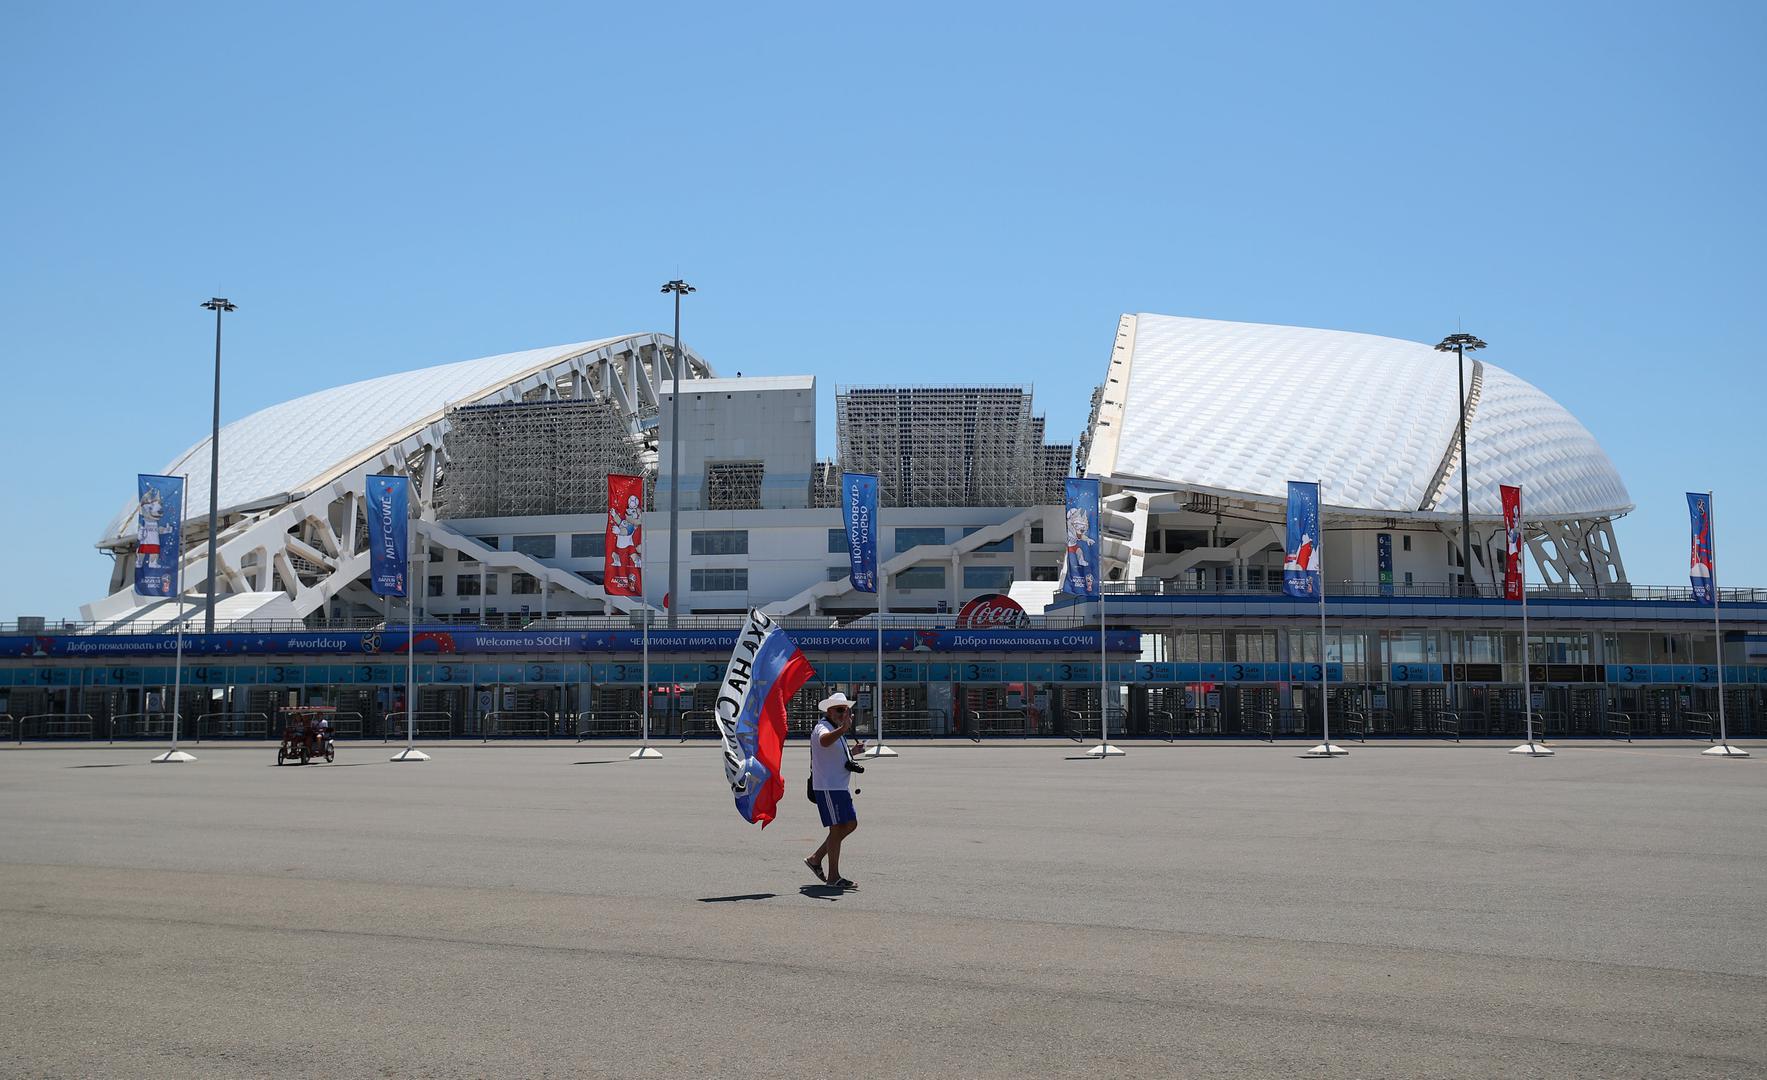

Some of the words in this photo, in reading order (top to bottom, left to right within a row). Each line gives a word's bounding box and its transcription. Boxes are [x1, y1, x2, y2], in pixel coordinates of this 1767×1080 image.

[67, 641, 97, 652] Добро
[98, 642, 155, 650] пожаловать
[288, 638, 347, 650] #worldcup
[476, 637, 522, 646] Welcome
[524, 638, 534, 646] to
[536, 637, 570, 646] SOCHI
[689, 637, 717, 646] МИРА
[718, 637, 732, 645] ПО
[801, 637, 822, 645] 2018
[823, 637, 830, 645] В
[831, 637, 870, 645] РОССИИ
[953, 636, 987, 647] Добро
[989, 638, 1051, 646] пожаловать
[1062, 636, 1093, 645] СОЧИ
[40, 668, 52, 684] 4
[112, 668, 125, 683] 4
[196, 667, 208, 683] 4
[272, 667, 284, 682] 3
[361, 666, 372, 682] 3
[441, 665, 452, 681] 3
[531, 665, 544, 682] 3
[614, 665, 626, 681] 3
[706, 664, 719, 681] 3
[884, 664, 897, 680] 3
[968, 664, 980, 680] 3
[1060, 664, 1073, 681] 3
[1142, 664, 1154, 680] 3
[1232, 664, 1244, 681] 3
[1311, 664, 1323, 681] 3
[1397, 665, 1408, 681] 3
[1624, 666, 1633, 682] 3
[1699, 666, 1708, 682] 3
